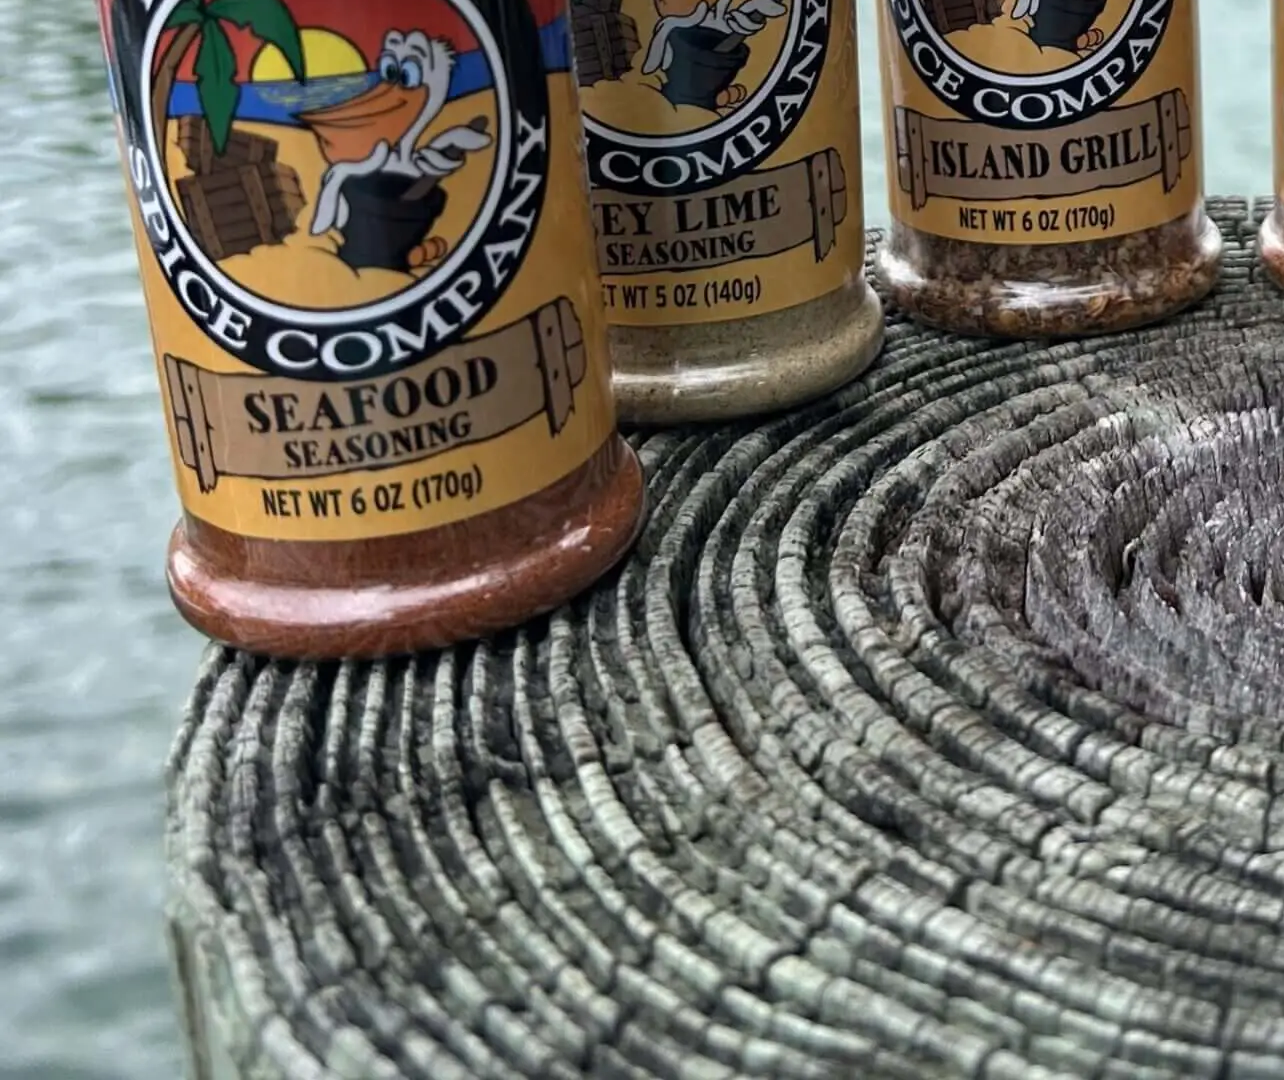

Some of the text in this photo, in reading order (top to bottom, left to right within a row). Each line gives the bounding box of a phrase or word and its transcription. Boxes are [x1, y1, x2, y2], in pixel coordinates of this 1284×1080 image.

[931, 123, 1158, 181] ISLAND GRILL
[593, 184, 781, 235] EY LIME
[959, 206, 1115, 231] NET WT 6 OZ (170g)
[129, 116, 546, 374] SPICE COMPANY
[606, 230, 756, 266] SEASONING
[622, 285, 648, 308] WT
[656, 285, 666, 307] 5
[673, 283, 697, 307] OZ
[703, 274, 761, 307] (140g)
[244, 354, 498, 434] SEAFOOD
[284, 412, 472, 469] SEASONING
[262, 467, 483, 517] NET WT 6 OZ (170g)
